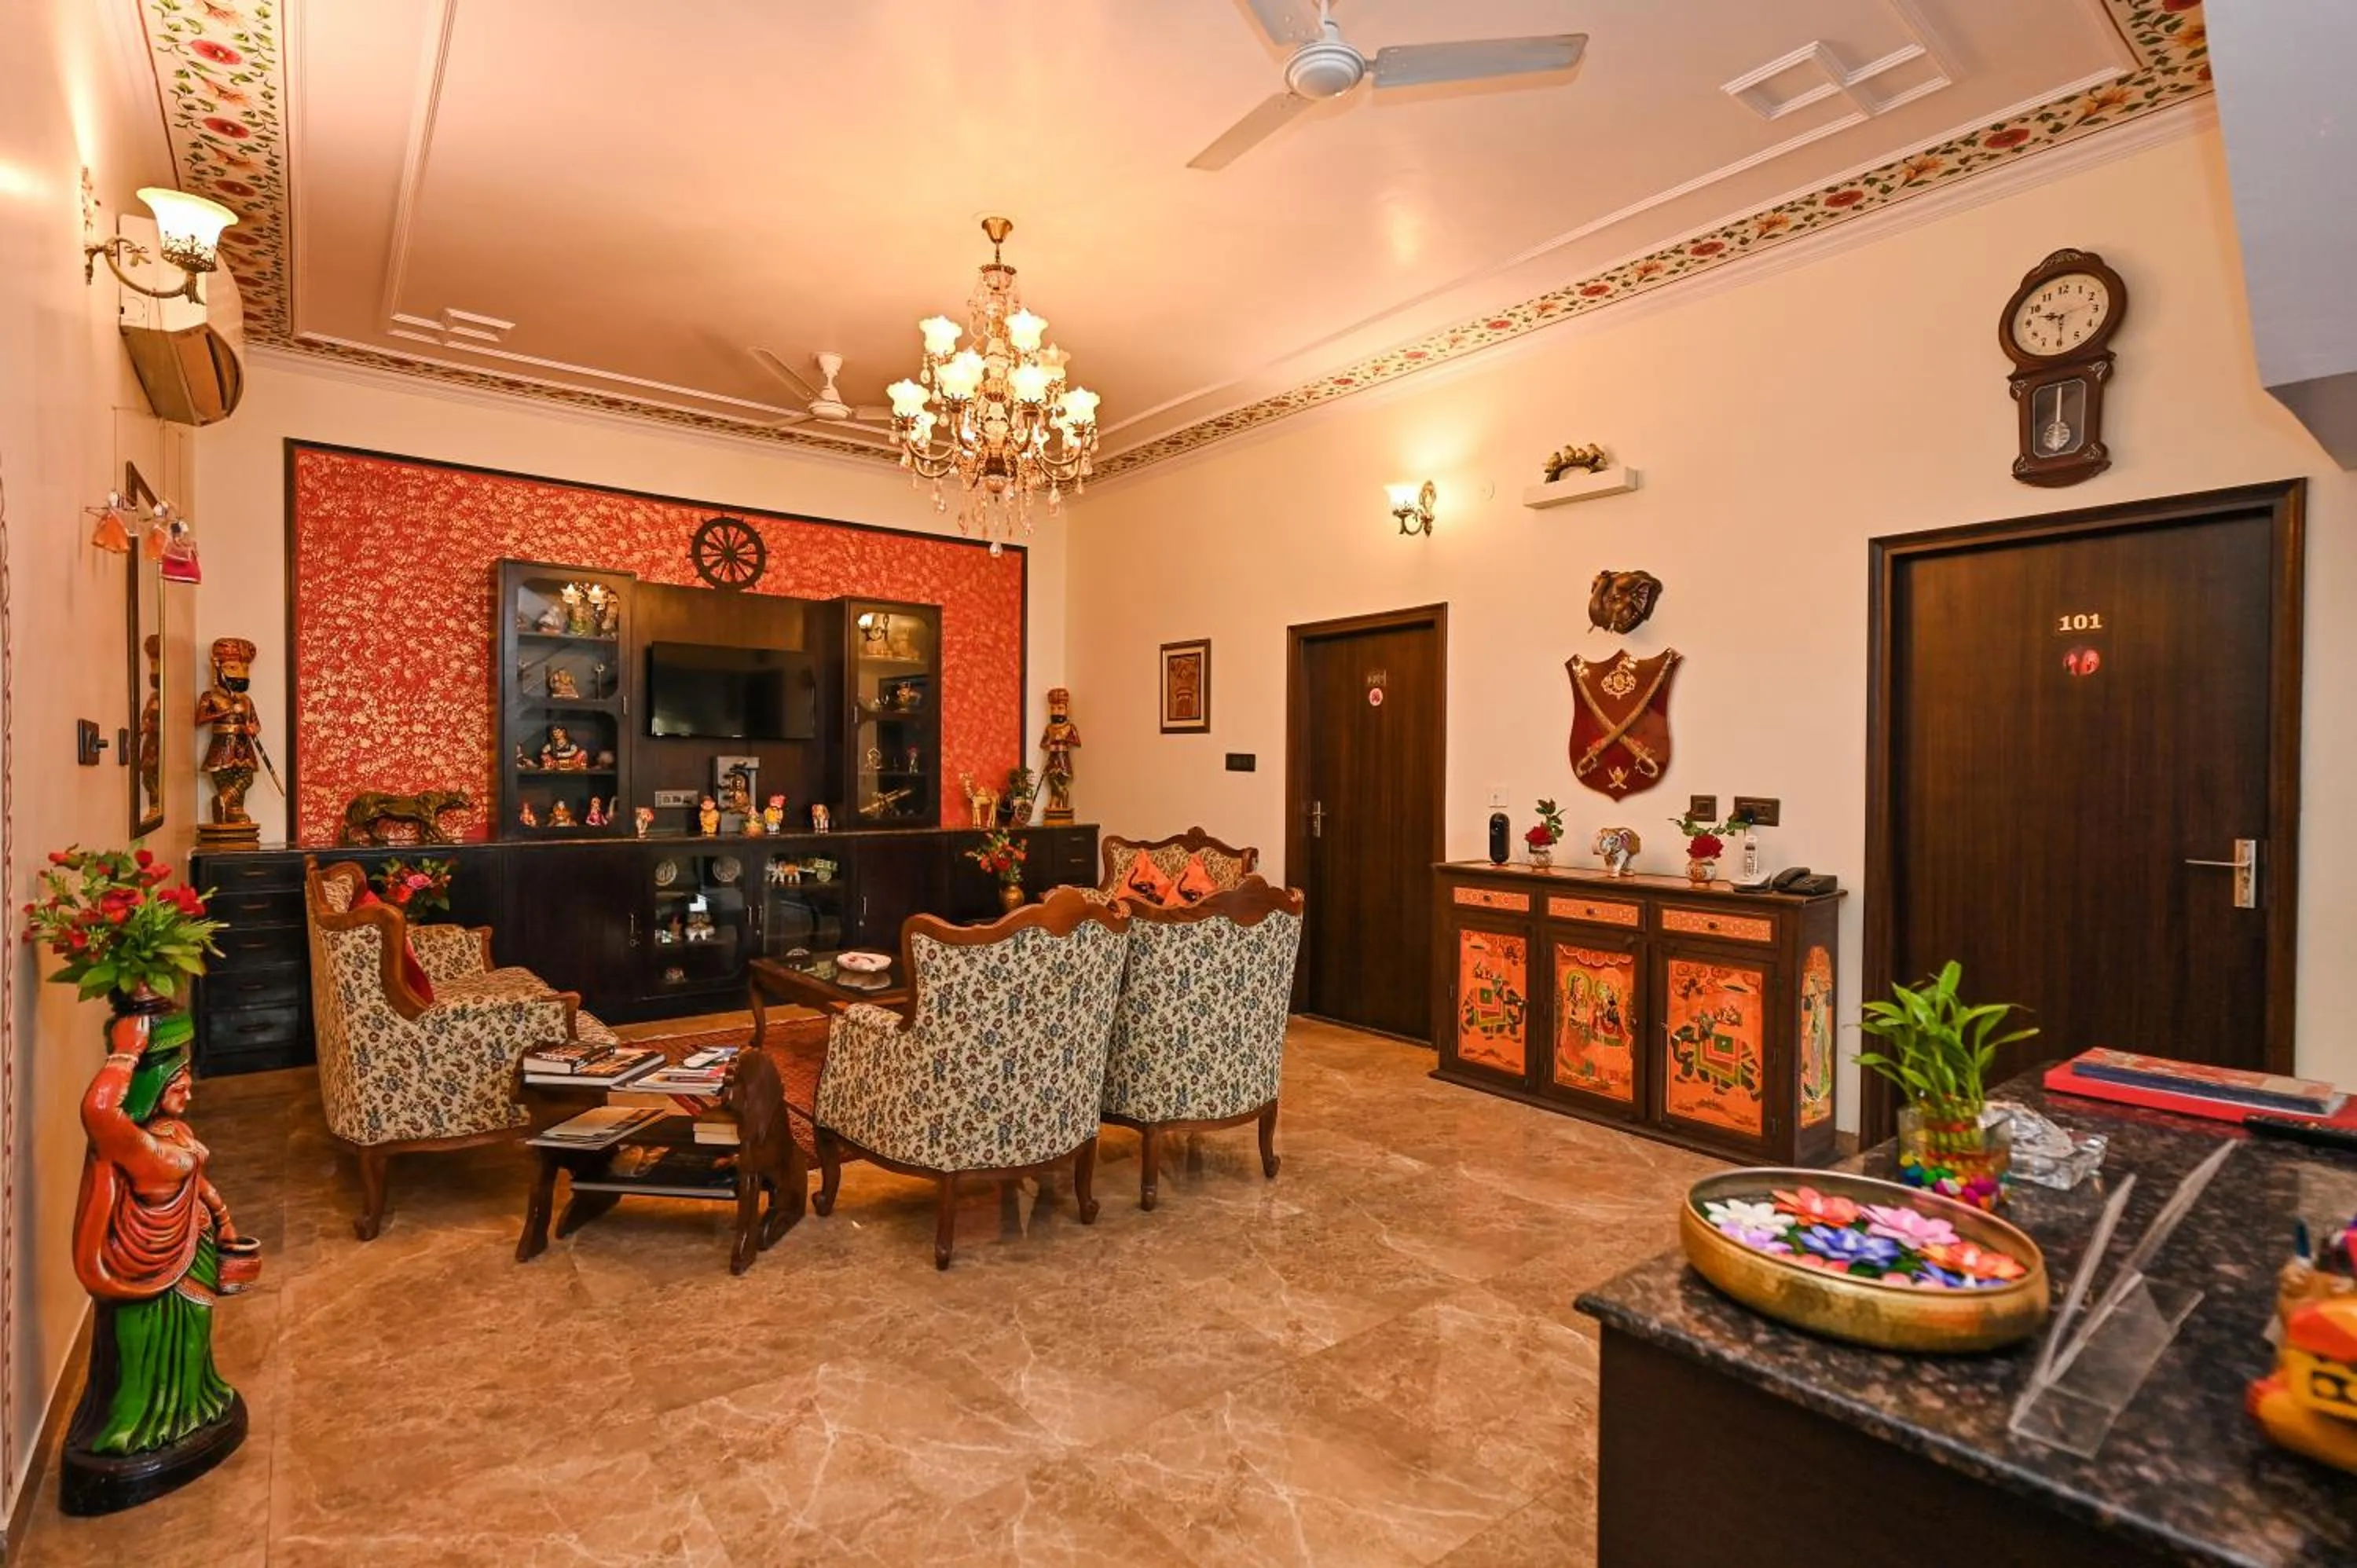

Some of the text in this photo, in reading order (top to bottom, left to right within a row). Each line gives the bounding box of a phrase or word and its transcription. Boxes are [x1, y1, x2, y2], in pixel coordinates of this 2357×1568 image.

[2058, 284, 2069, 295] 12
[2077, 284, 2083, 295] 1
[2042, 292, 2051, 302] 11
[2088, 291, 2095, 301] 2
[2031, 304, 2041, 314] 10
[2093, 303, 2099, 313] 3
[2074, 330, 2080, 340] 5
[2059, 613, 2102, 631] 101
